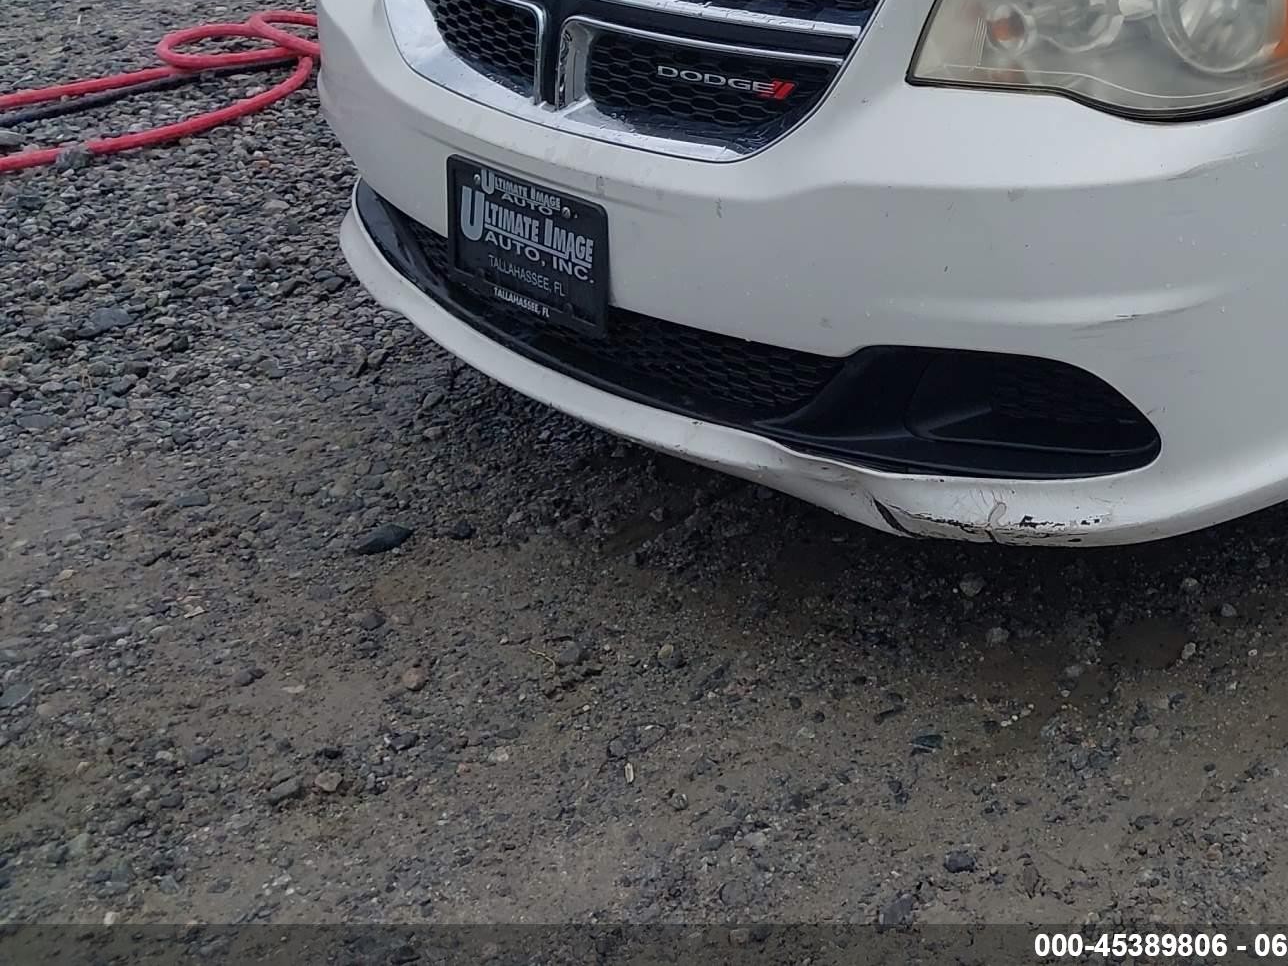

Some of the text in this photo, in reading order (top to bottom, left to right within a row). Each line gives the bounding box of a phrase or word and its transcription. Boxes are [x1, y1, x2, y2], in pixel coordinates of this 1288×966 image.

[657, 65, 775, 95] DODGE
[481, 169, 561, 211] ULTIMATE IMAGE
[502, 193, 553, 215] AUTO
[461, 186, 594, 265] ULTIMATE IMAGE
[485, 231, 595, 283] AUTO, INC.
[488, 254, 565, 296] TALLAHASSEE, FL
[542, 307, 550, 317] FL
